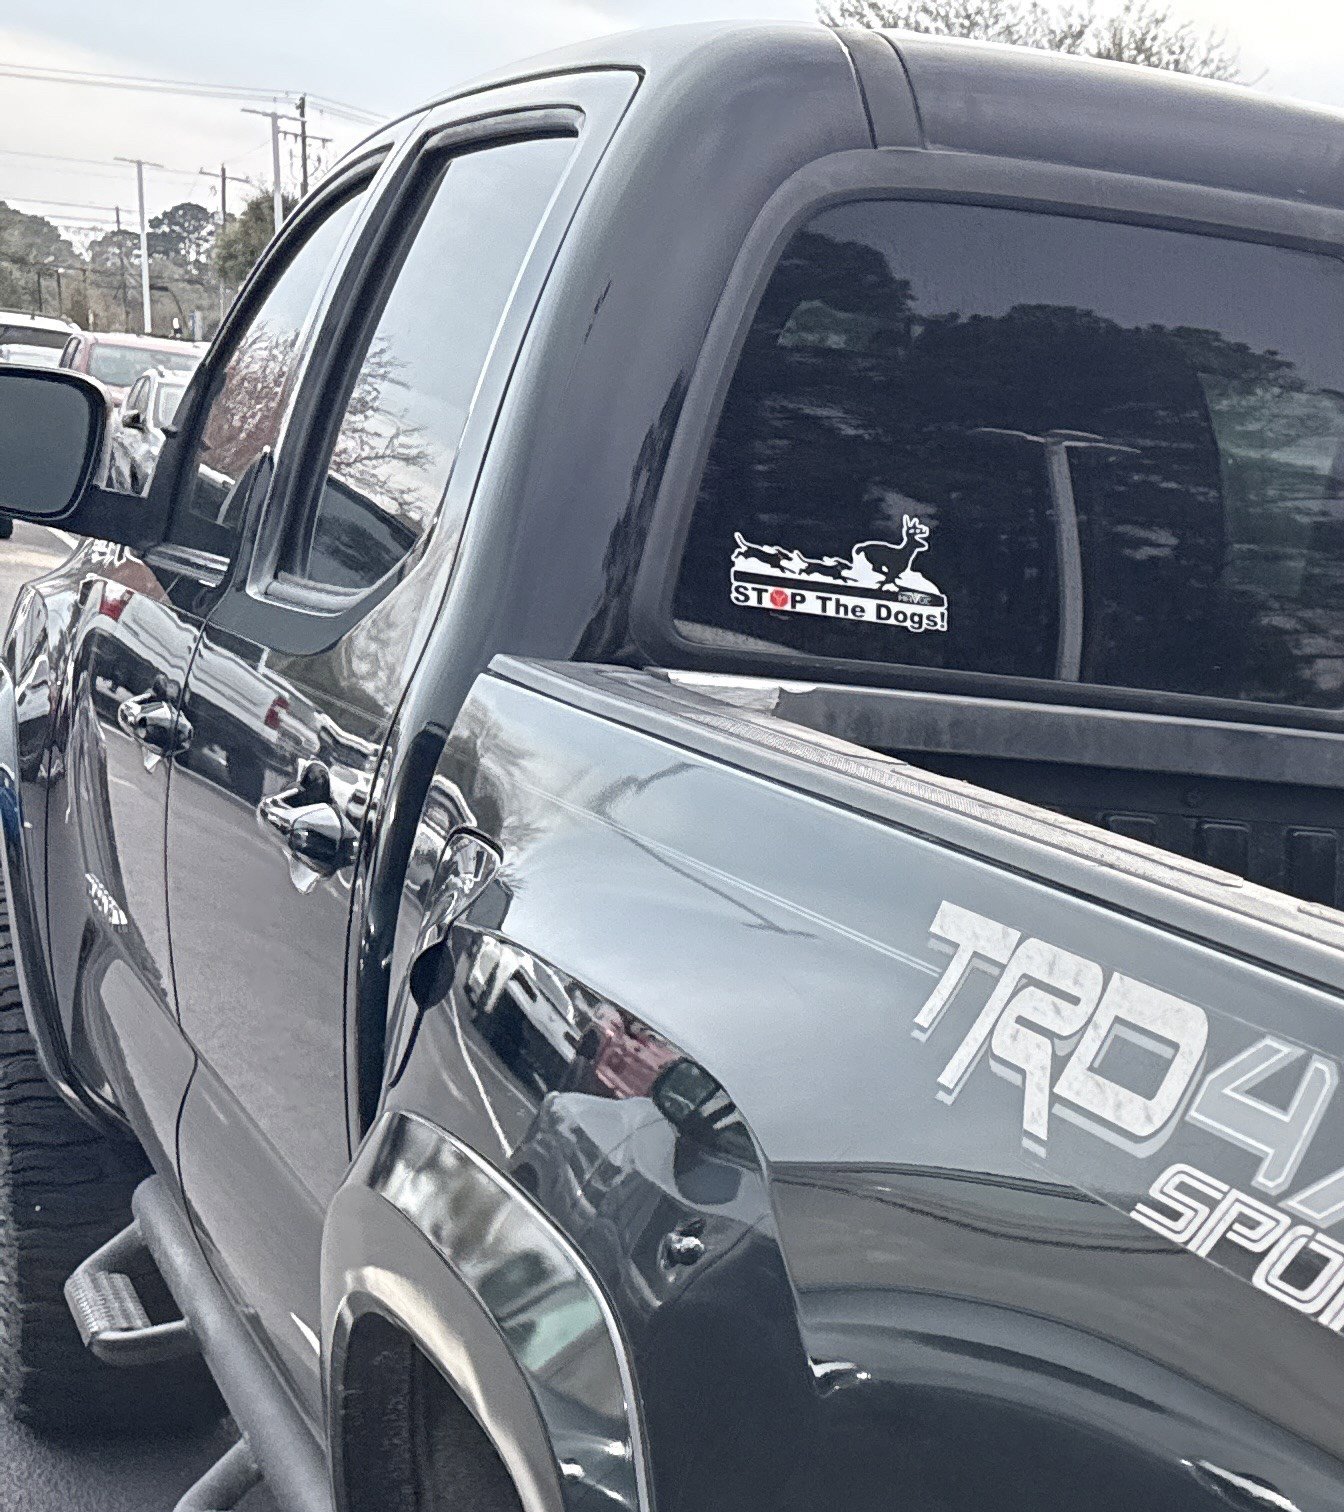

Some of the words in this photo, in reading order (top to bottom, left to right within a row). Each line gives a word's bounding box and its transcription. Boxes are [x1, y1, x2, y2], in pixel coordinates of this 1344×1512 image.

[733, 584, 806, 609] STOP
[816, 595, 866, 618] The
[876, 603, 945, 630] Dogs!
[911, 900, 1208, 1158] TRD
